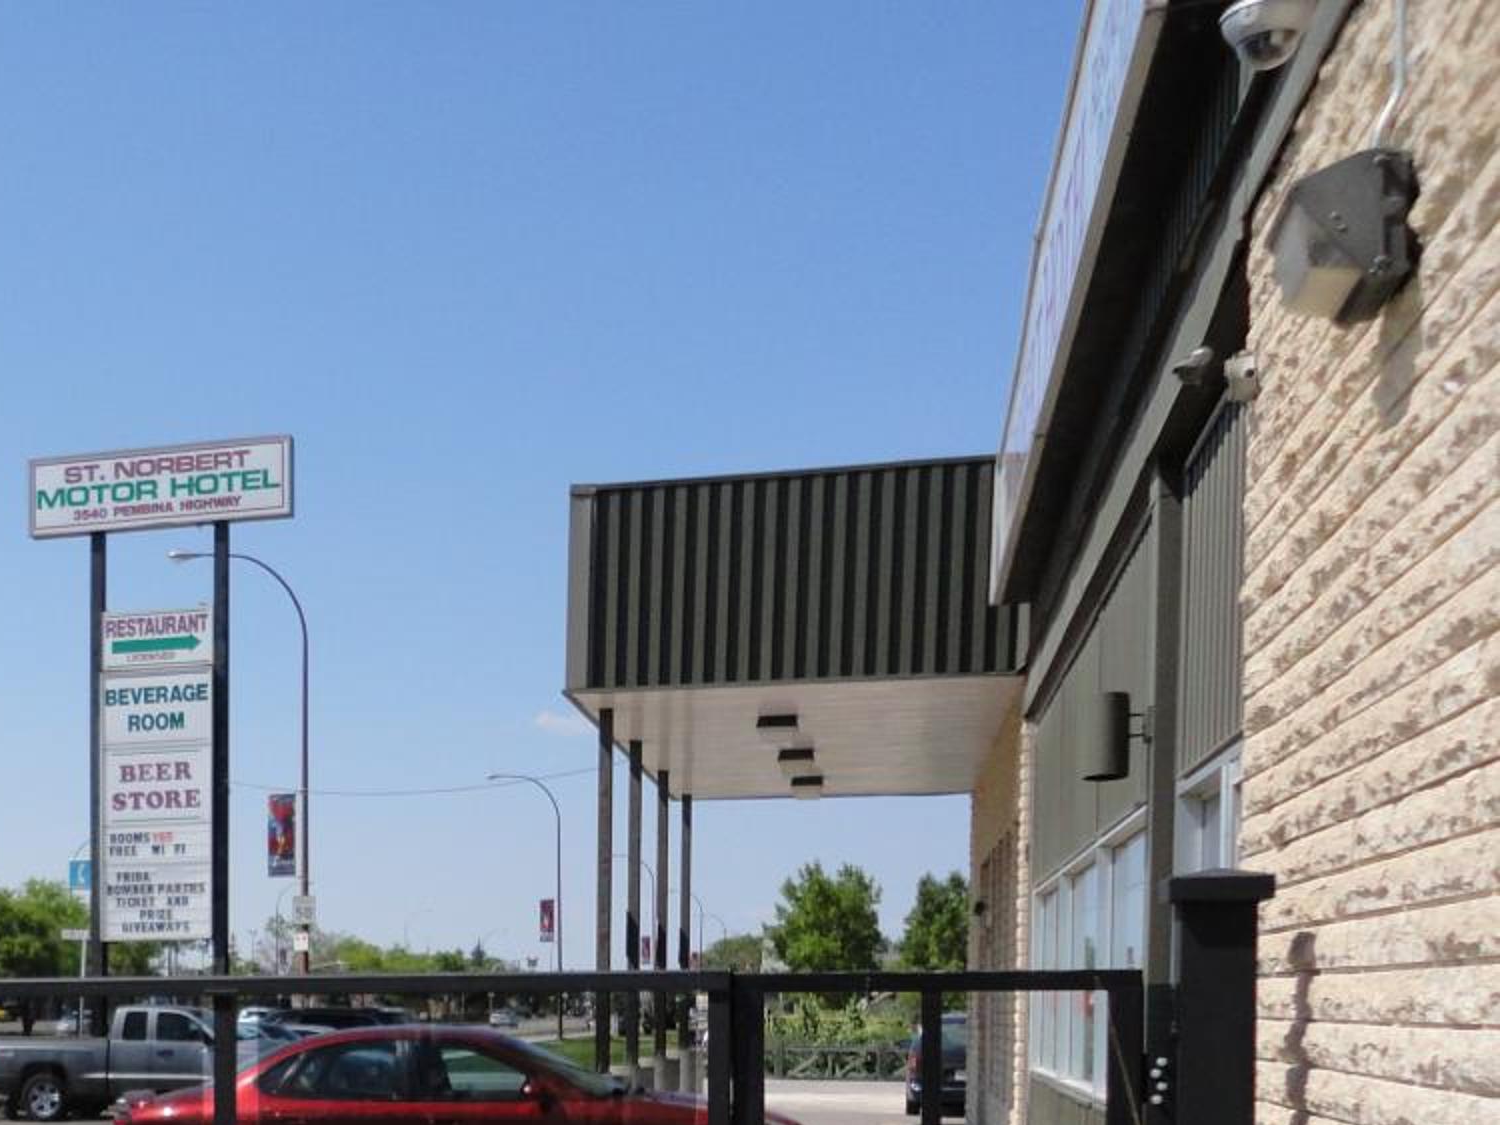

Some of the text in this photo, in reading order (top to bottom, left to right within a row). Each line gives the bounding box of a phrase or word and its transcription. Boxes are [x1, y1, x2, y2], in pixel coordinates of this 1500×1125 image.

[64, 450, 251, 485] ST. NORBERT
[36, 468, 281, 510] MOTOR HOTEL
[73, 495, 243, 521] 3540 PEMBINA HIGHWAY
[105, 613, 209, 638] RESTAURANT
[105, 683, 209, 707] BEVERAGE
[127, 711, 185, 732] ROOM
[119, 761, 193, 783] BEER
[112, 789, 201, 811] STORE
[109, 831, 150, 844] ROOMS
[109, 845, 138, 857] FREE
[121, 921, 190, 934] GIVEAWAYS
